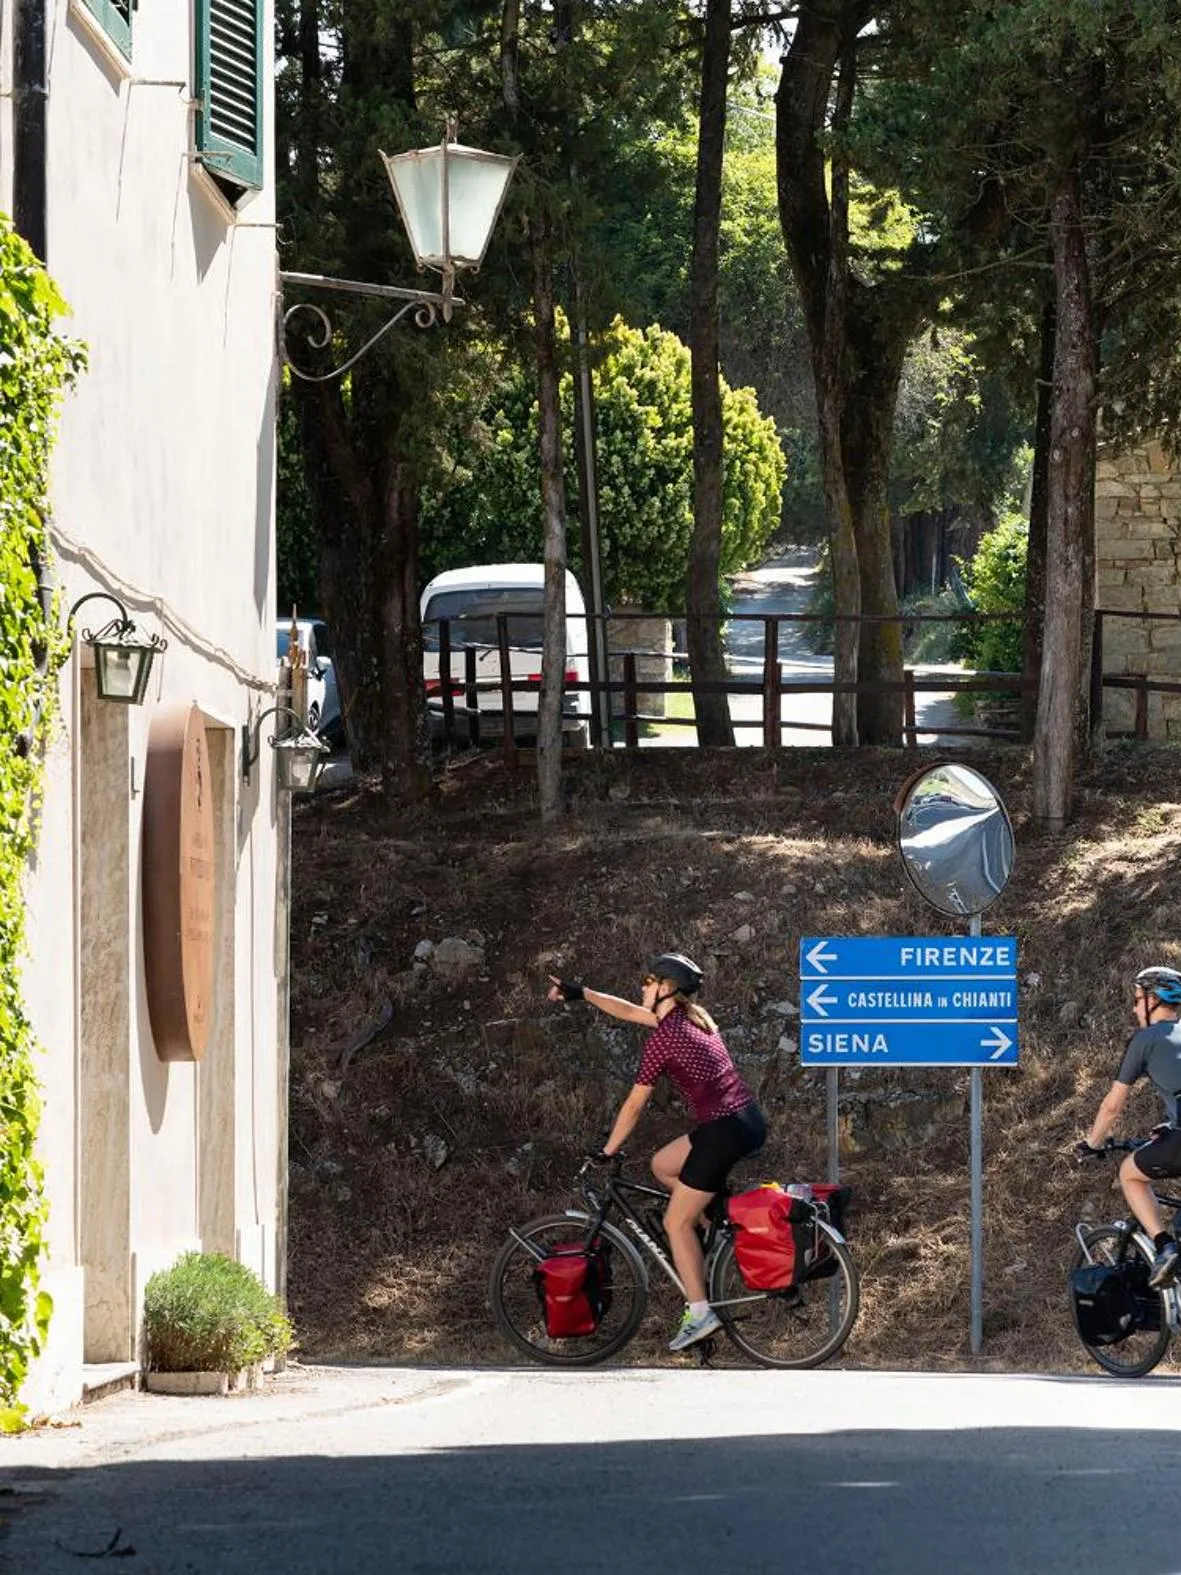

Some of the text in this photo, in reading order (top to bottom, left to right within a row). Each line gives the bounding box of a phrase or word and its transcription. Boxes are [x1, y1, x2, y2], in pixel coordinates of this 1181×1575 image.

[900, 947, 1011, 966] FIRENZE
[848, 992, 933, 1008] CASTELLINA
[952, 992, 1012, 1008] CHIANTI
[807, 1034, 889, 1053] SIENA
